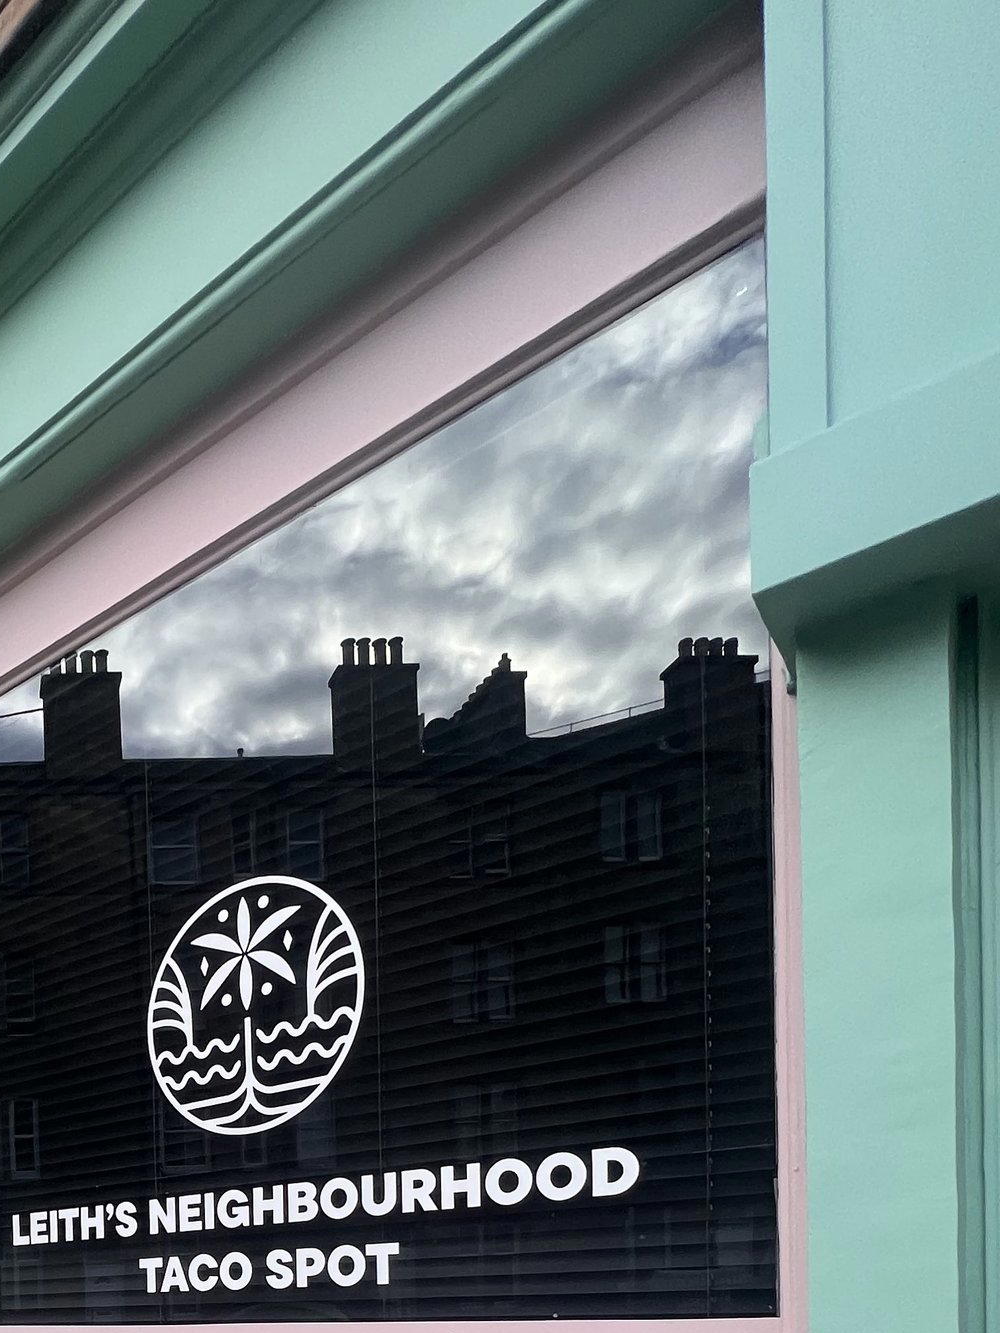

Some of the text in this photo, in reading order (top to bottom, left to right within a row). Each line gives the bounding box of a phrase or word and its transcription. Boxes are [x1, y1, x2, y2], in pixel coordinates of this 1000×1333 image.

[12, 1146, 641, 1247] LEITH’S NEIGHBOURHOOD
[138, 1241, 400, 1294] TACO SPOT
